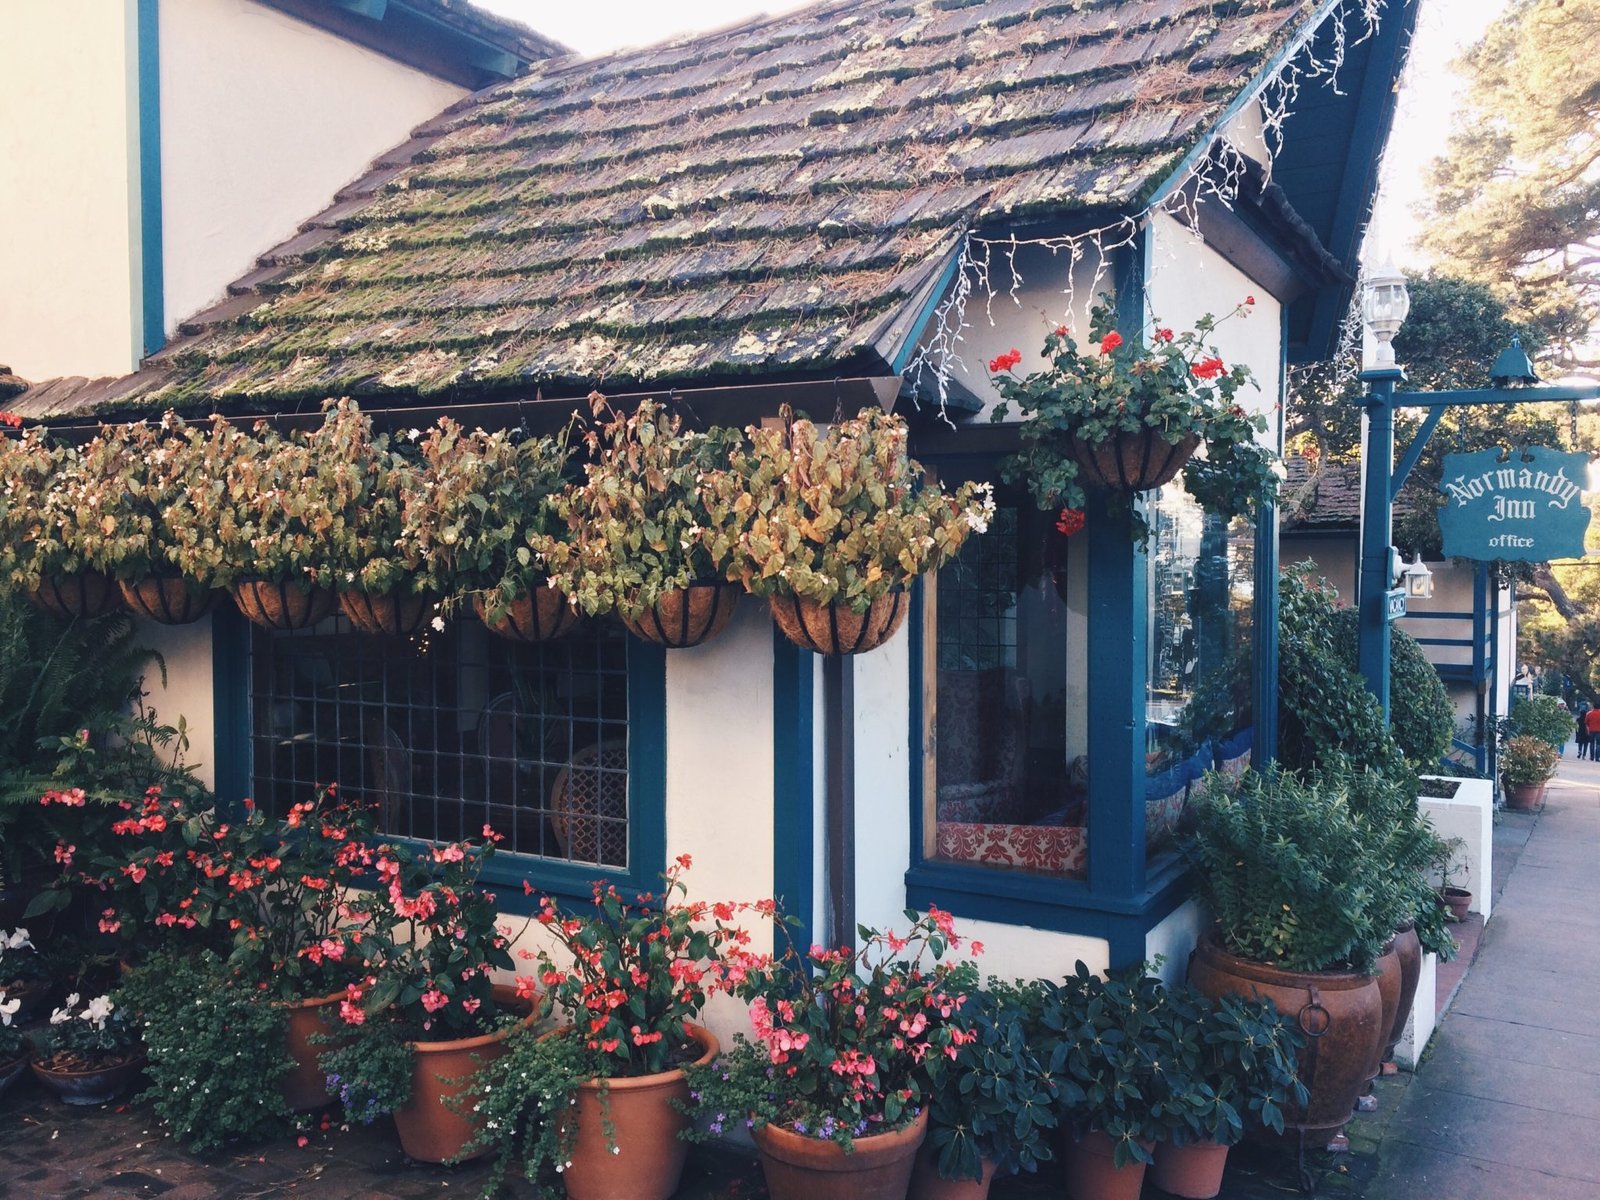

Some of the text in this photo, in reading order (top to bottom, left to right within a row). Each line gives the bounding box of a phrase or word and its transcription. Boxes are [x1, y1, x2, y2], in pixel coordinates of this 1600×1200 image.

[1446, 467, 1581, 510] Normandy
[1487, 494, 1537, 522] Inn
[1488, 534, 1535, 548] office
